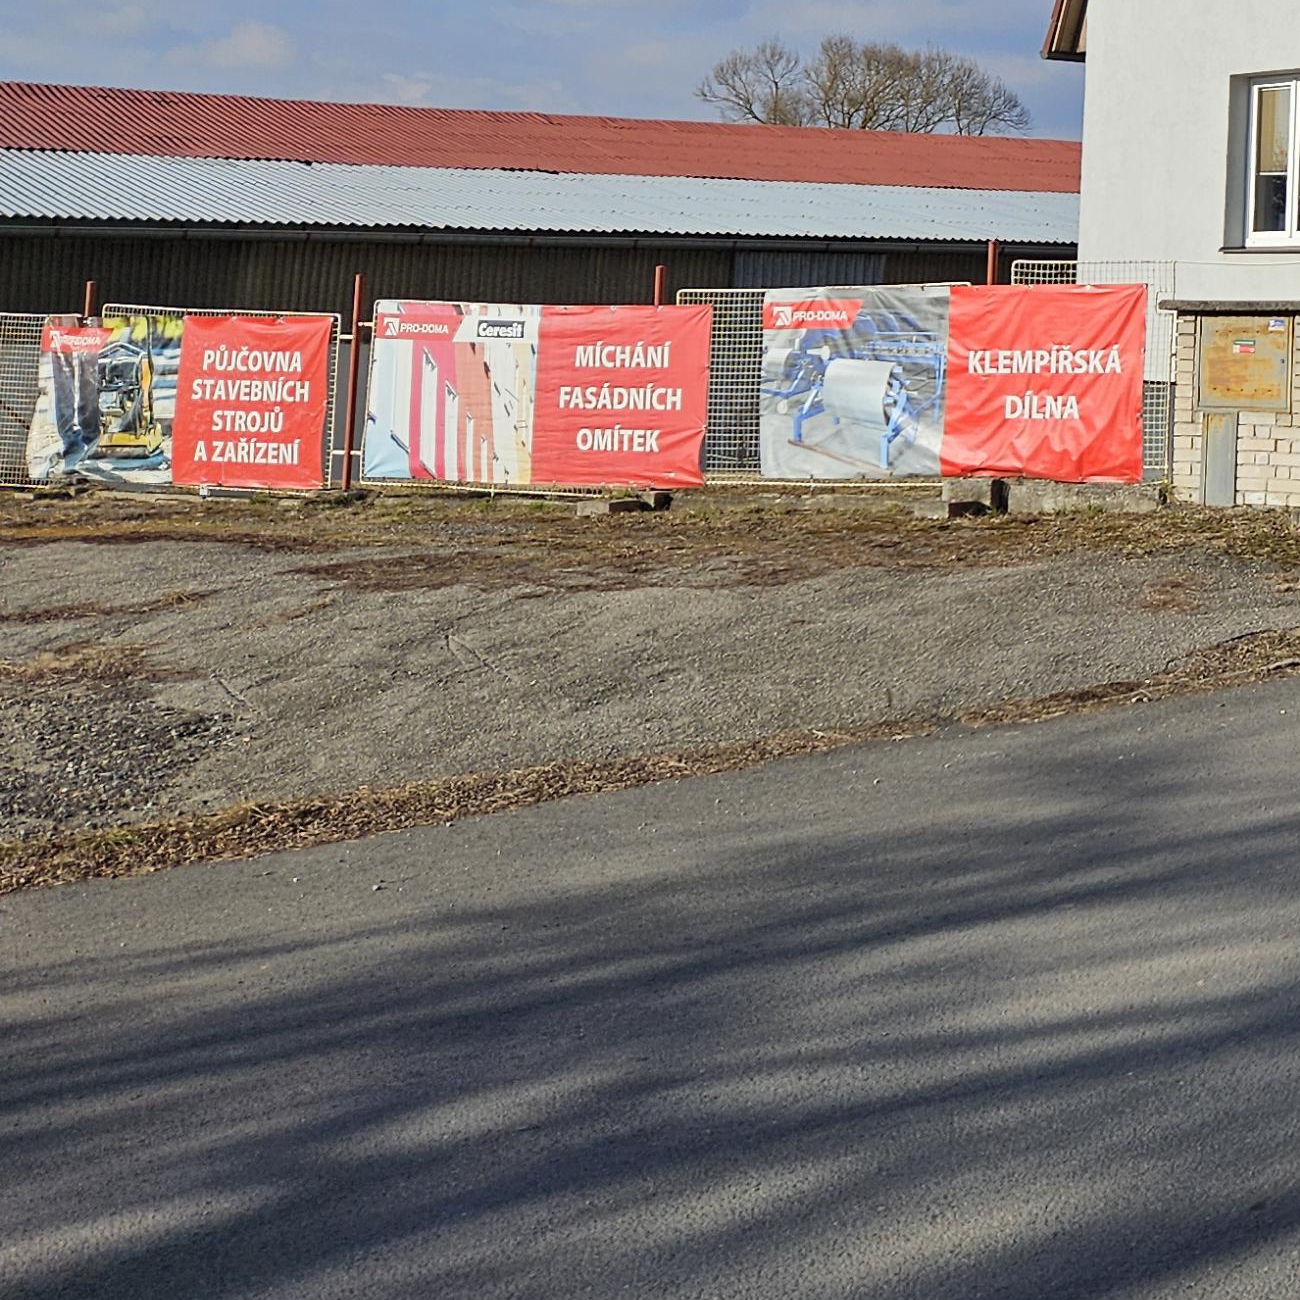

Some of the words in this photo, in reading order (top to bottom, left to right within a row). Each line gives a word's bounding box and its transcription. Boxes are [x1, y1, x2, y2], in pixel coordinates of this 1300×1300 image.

[400, 322, 449, 334] PRO-DOMA
[479, 321, 523, 338] Ceresit
[792, 310, 848, 322] PRO-DOMA
[202, 344, 302, 372] PŮJČOVNA
[574, 340, 672, 368] MÍCHÁNÍ
[967, 344, 1122, 374] KLEMPÍŘSKÁ
[191, 376, 310, 402] STAVEBNÍCH
[558, 382, 683, 411] FASÁDNÍCH
[211, 405, 284, 433] STROJŮ
[1004, 390, 1080, 420] DÍLNA
[193, 440, 208, 462] A
[210, 437, 301, 465] ZAŘÍZENÍ
[575, 424, 661, 453] OMÍTEK
